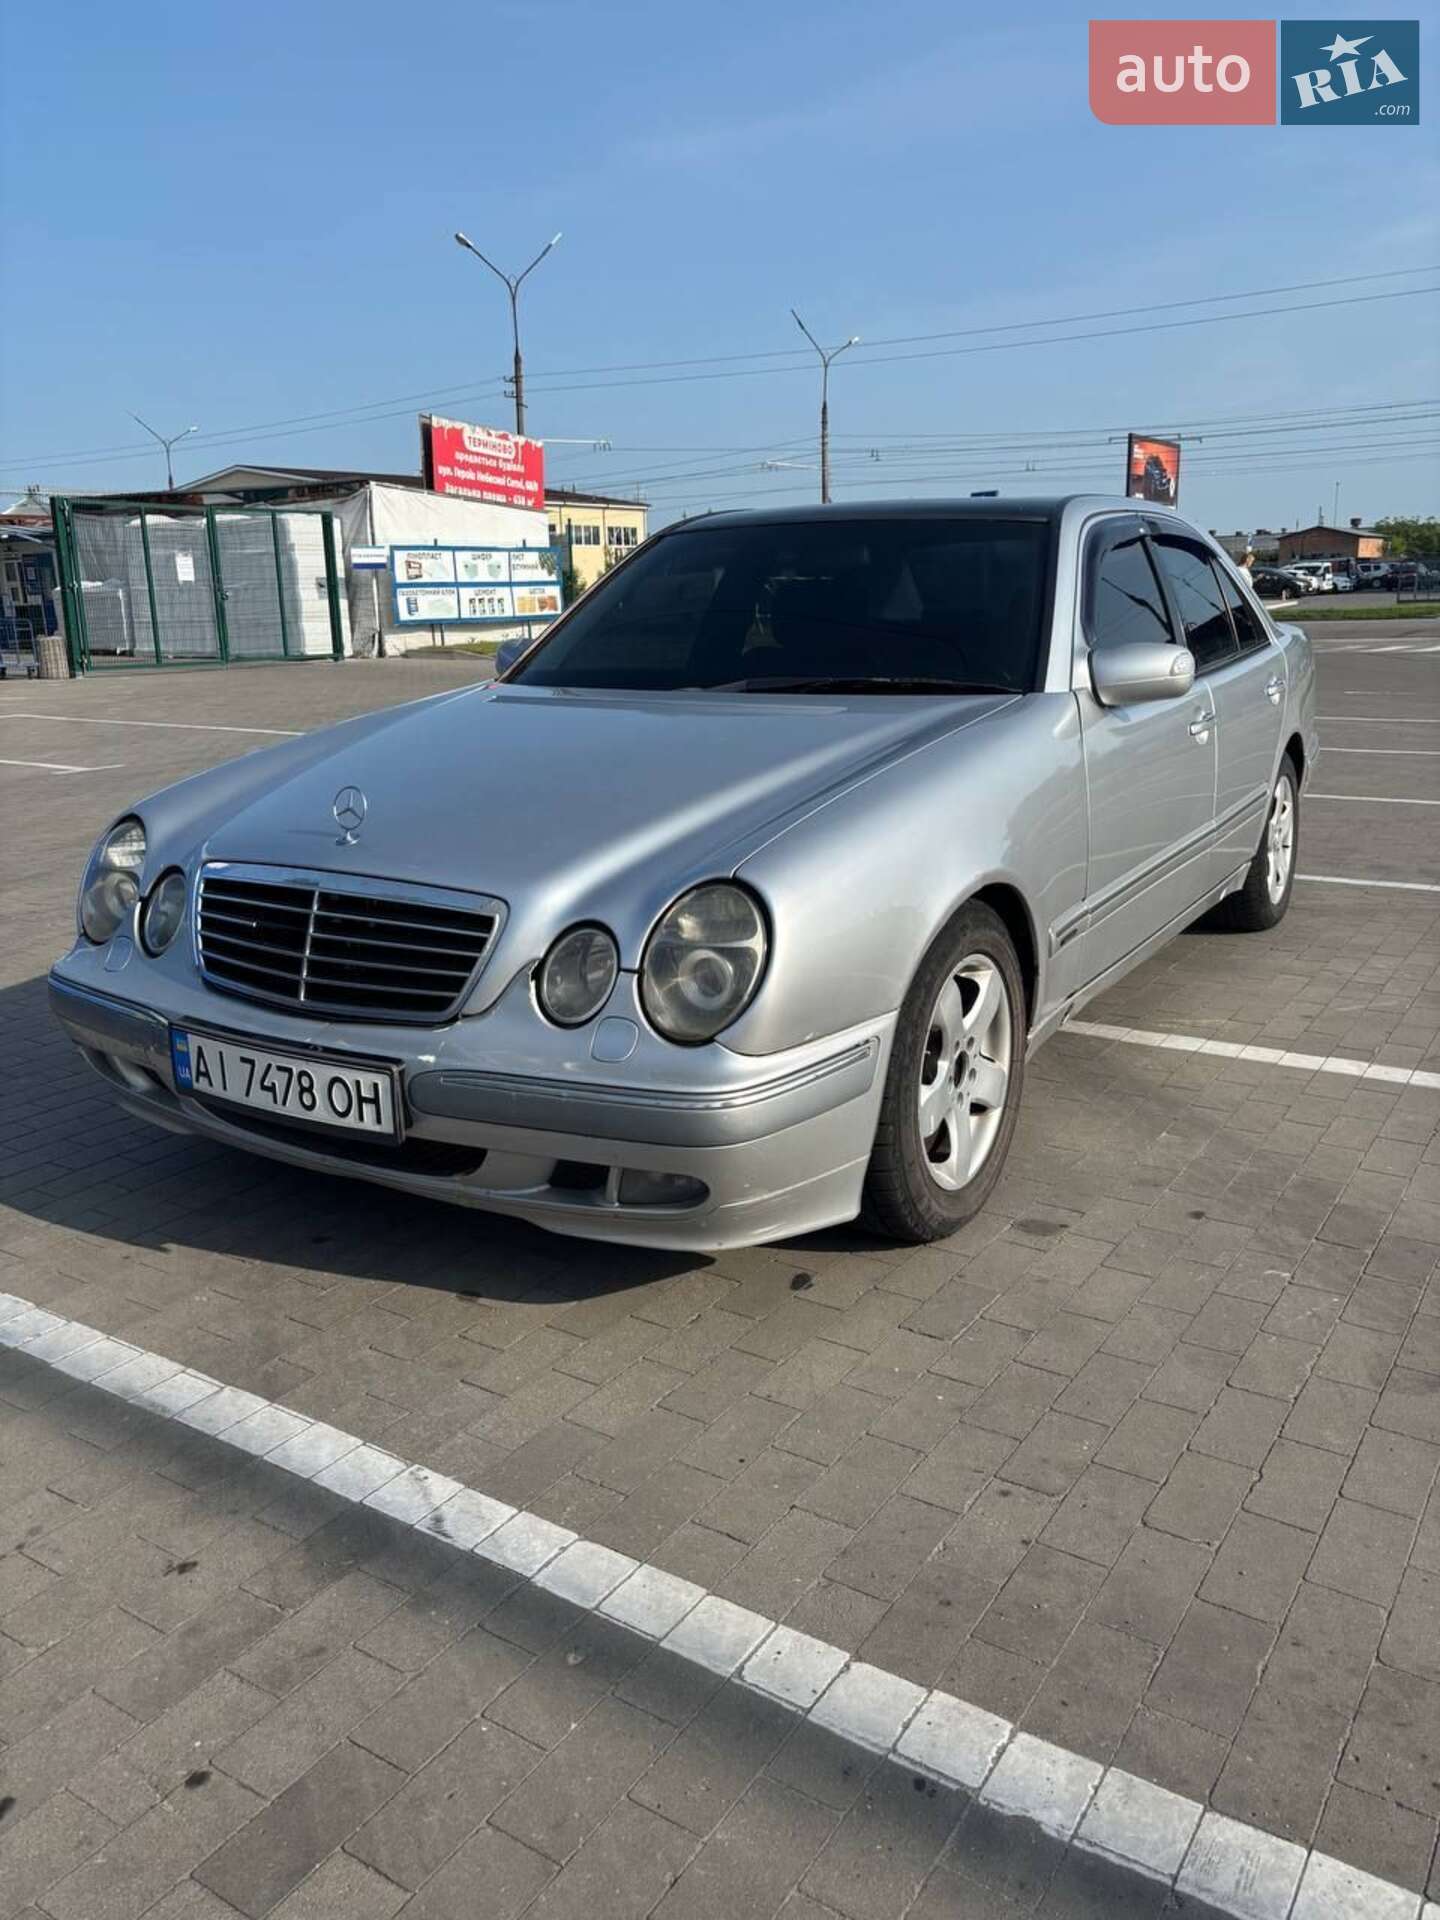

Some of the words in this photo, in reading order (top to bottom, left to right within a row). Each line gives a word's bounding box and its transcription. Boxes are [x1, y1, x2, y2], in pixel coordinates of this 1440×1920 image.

[467, 435, 514, 455] ТЕРМІНОВО
[445, 483, 481, 497] Загальна
[178, 1065, 192, 1080] UA
[195, 1045, 228, 1092] AI
[240, 1056, 318, 1111] 7478
[327, 1075, 382, 1125] OH
